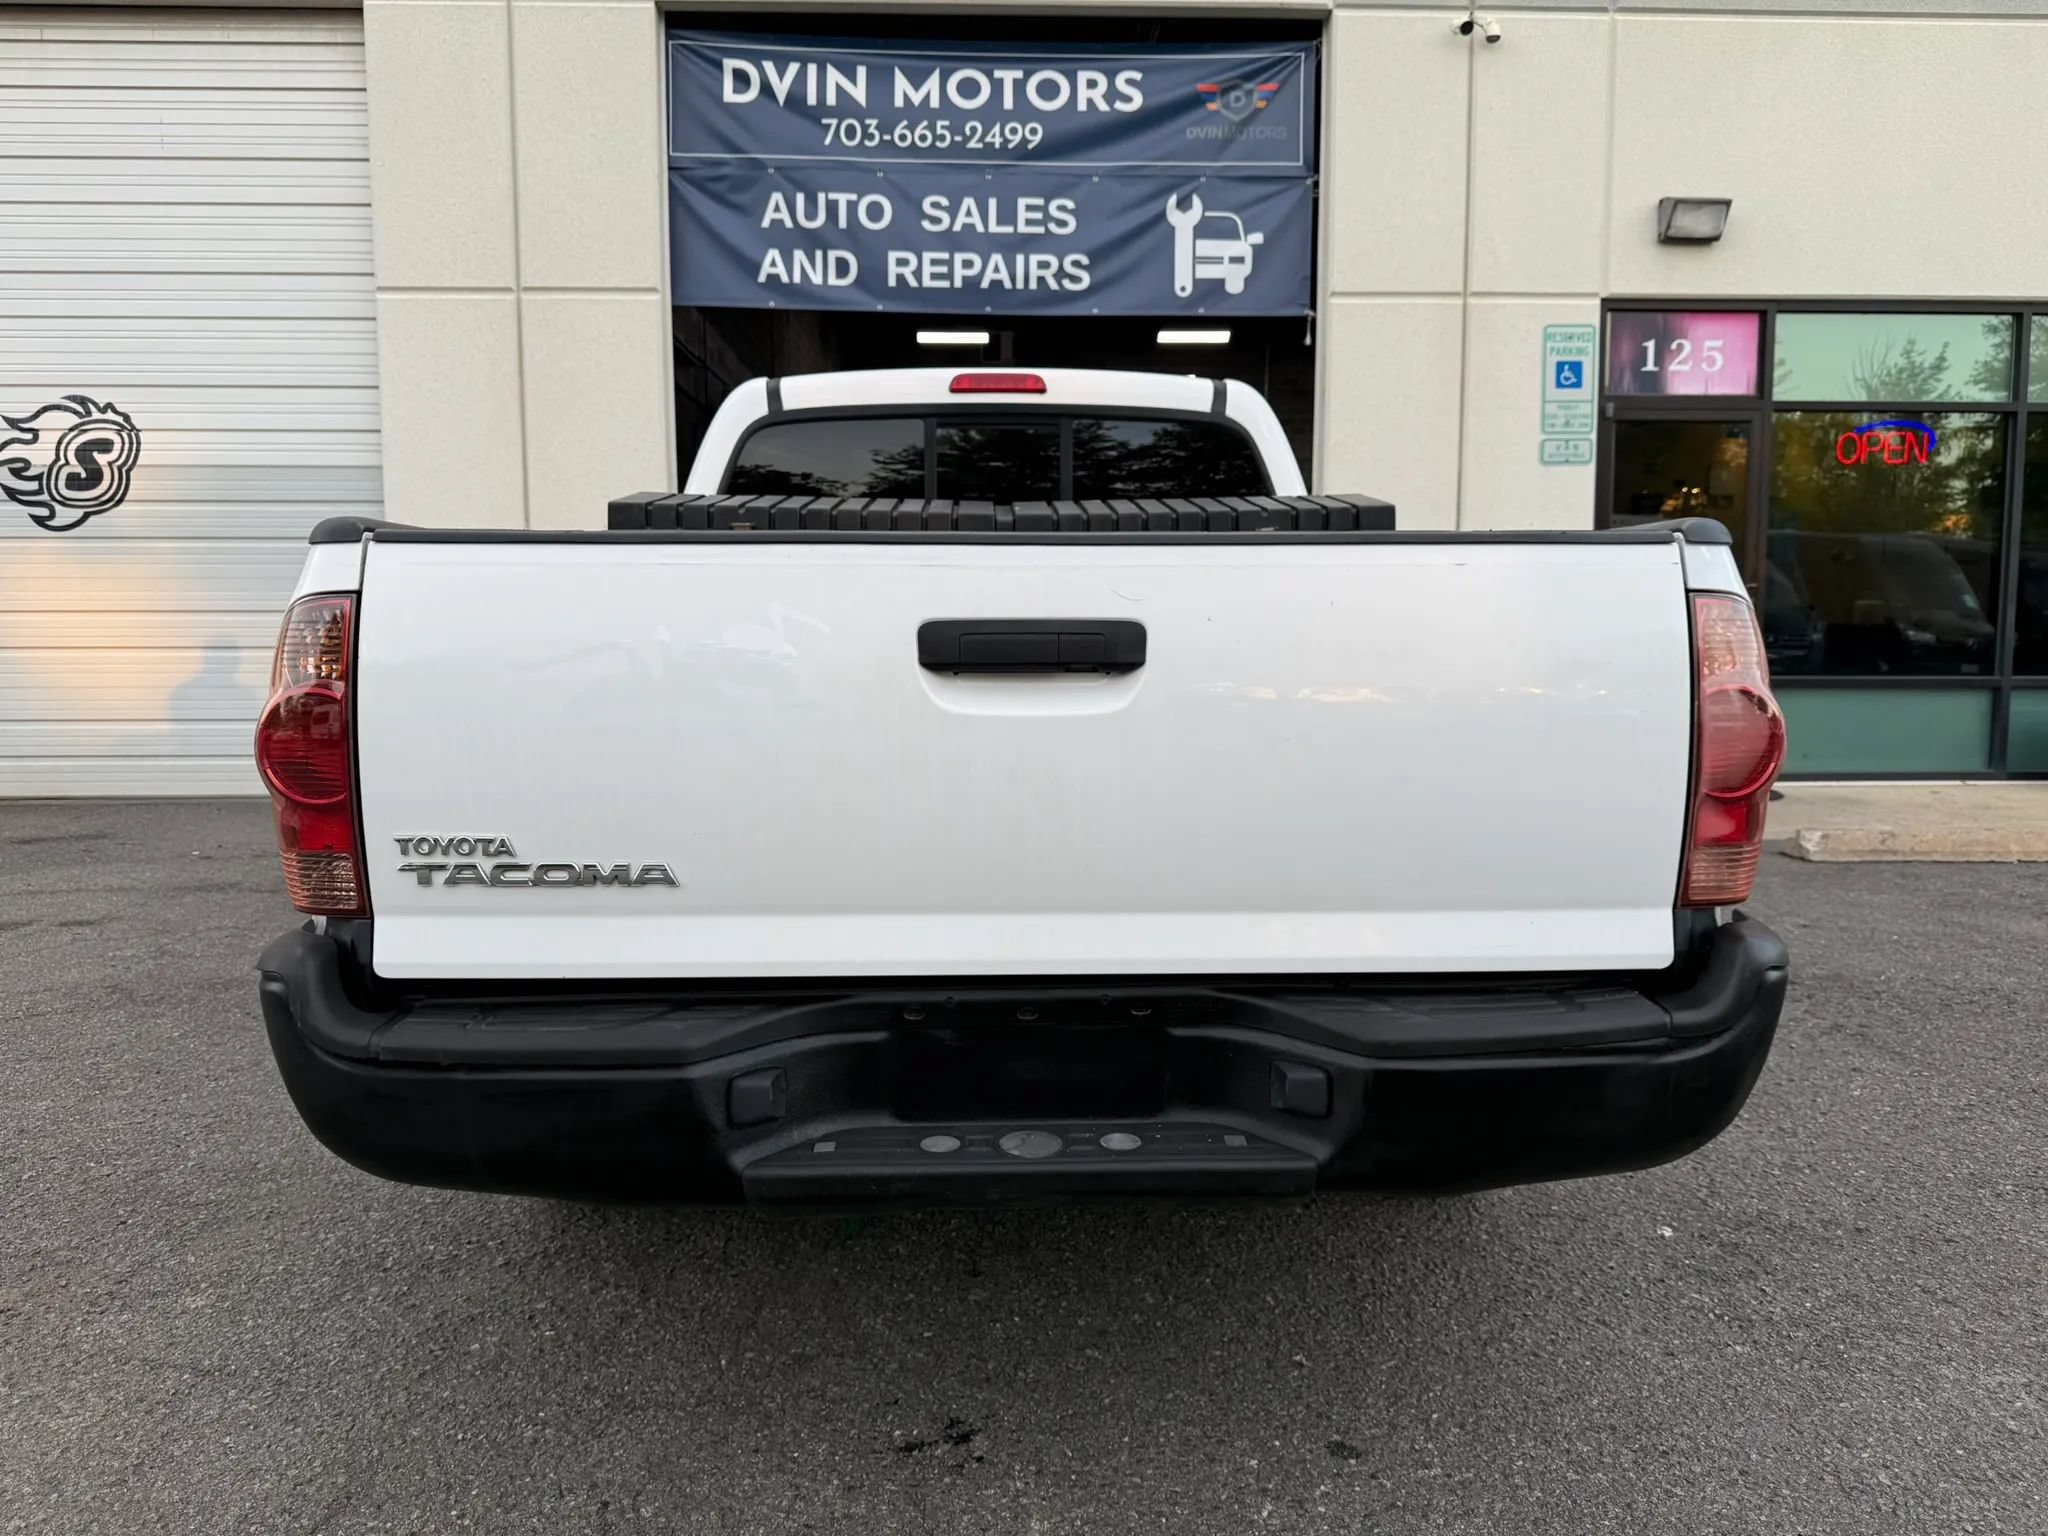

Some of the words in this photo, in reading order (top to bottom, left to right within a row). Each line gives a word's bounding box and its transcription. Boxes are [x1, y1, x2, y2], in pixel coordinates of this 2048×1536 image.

[722, 57, 867, 108] DVIN
[894, 65, 1144, 112] MOTORS
[821, 117, 1044, 150] 703-665-2499
[760, 191, 893, 230] AUTO
[921, 195, 1077, 235] SALES
[757, 248, 859, 287] AND
[887, 250, 1091, 291] REPAIRS
[1640, 339, 1724, 372] 125
[1836, 431, 1930, 465] OPEN
[394, 834, 517, 857] TOYOTA
[397, 861, 680, 887] TACOMA
